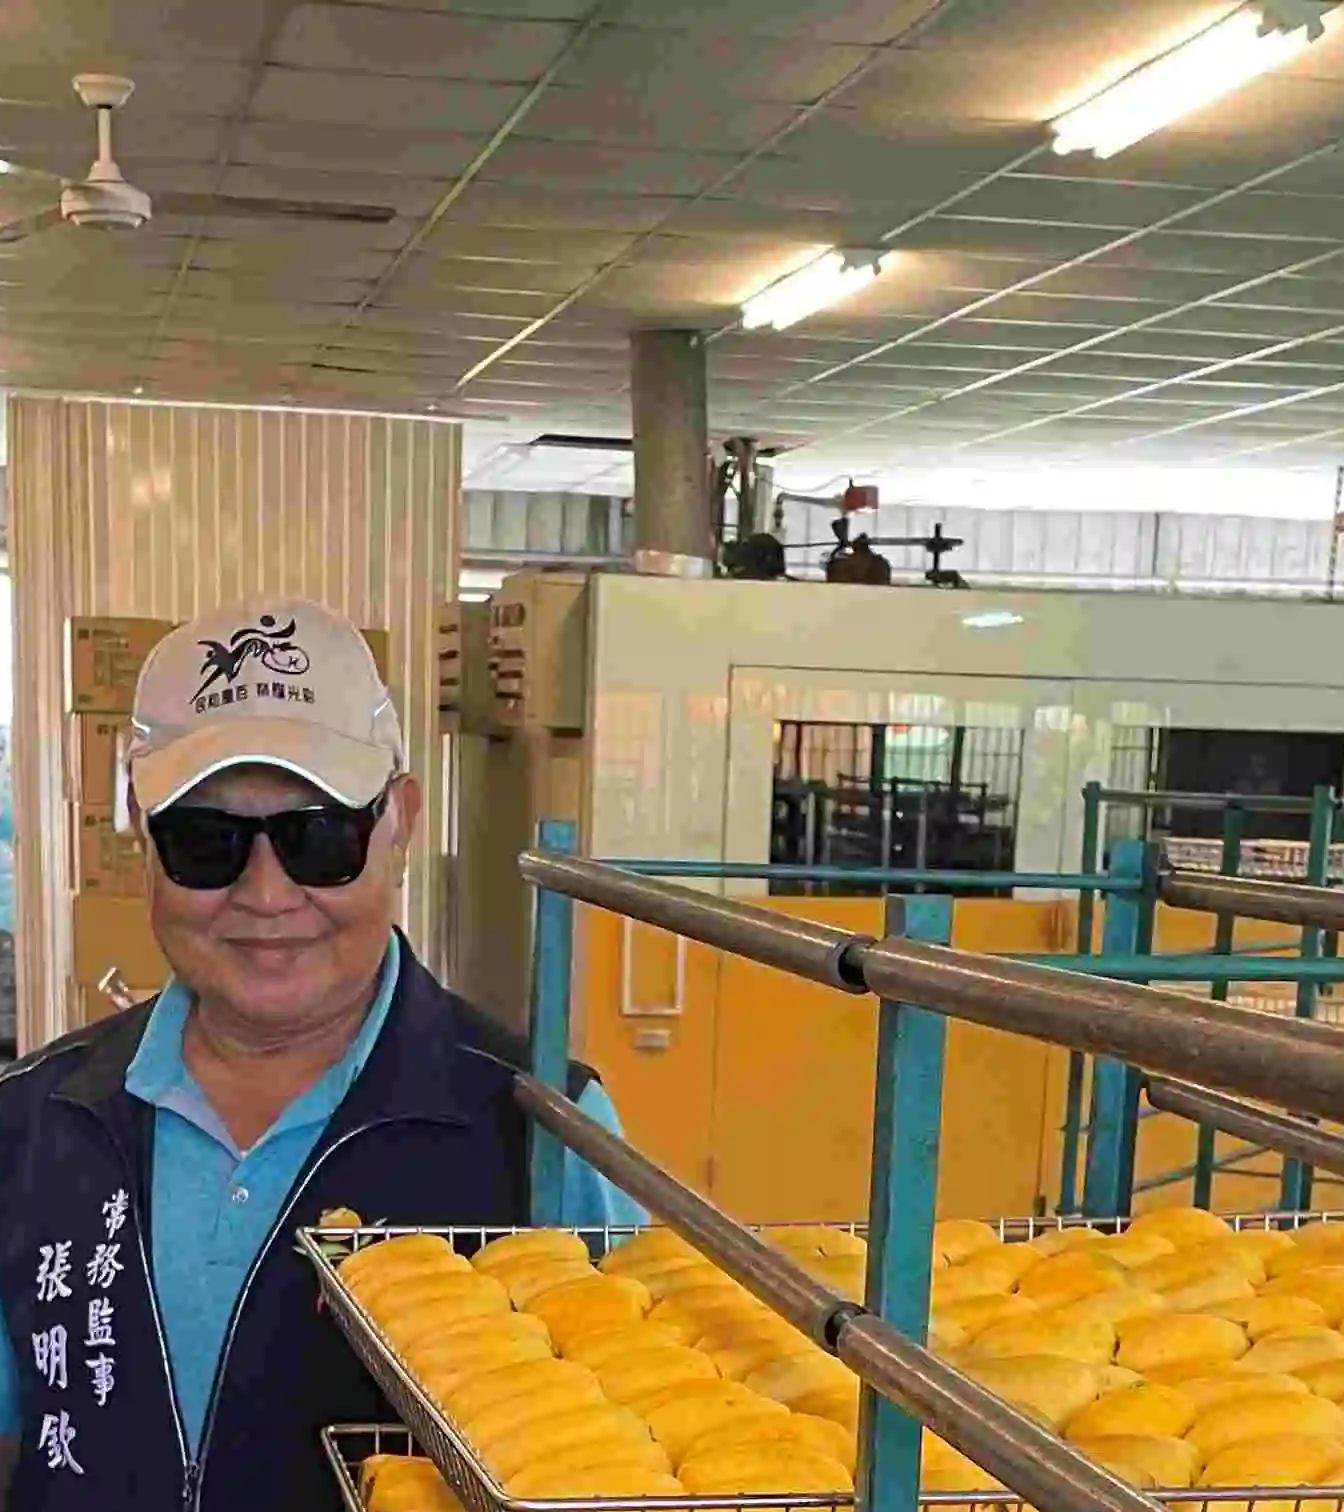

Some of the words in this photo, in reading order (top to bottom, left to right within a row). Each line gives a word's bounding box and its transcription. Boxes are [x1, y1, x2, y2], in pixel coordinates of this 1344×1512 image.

[31, 1239, 85, 1477] 張明欽
[83, 1188, 131, 1408] 常務監事
